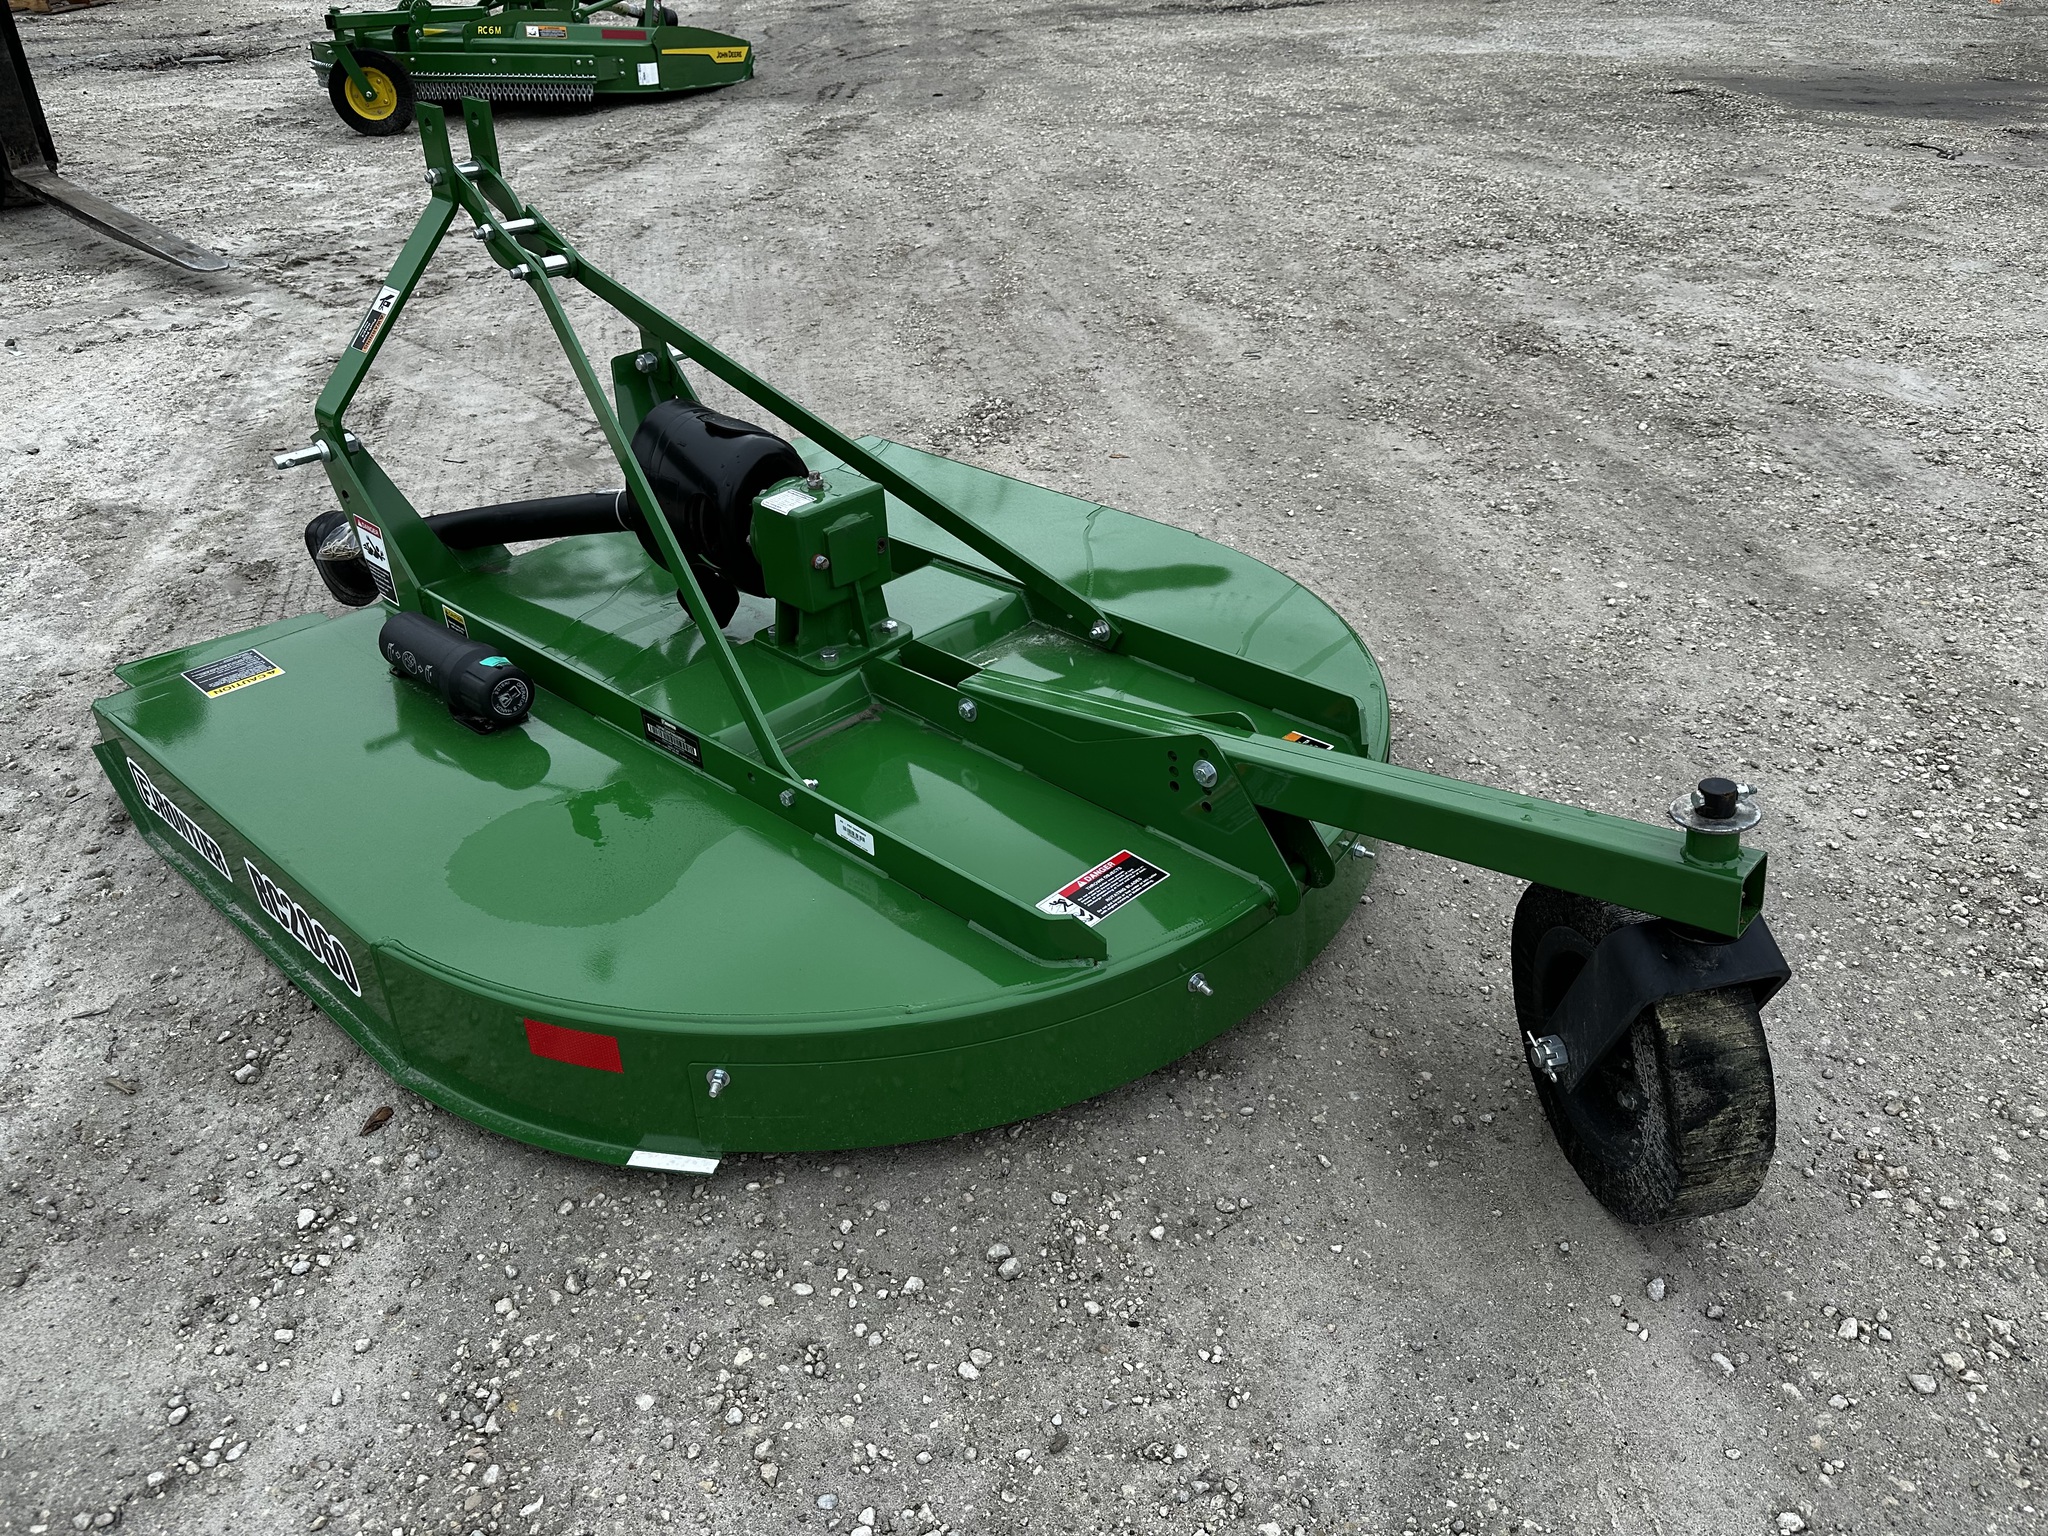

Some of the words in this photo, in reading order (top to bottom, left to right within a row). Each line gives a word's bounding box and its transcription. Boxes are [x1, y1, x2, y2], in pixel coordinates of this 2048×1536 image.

[716, 50, 728, 59] JOHN
[728, 50, 743, 58] DEERE
[213, 674, 266, 695] CAUTION
[126, 756, 233, 883] FRONTIER
[1085, 861, 1116, 883] DANGER
[243, 856, 362, 997] RC2060
